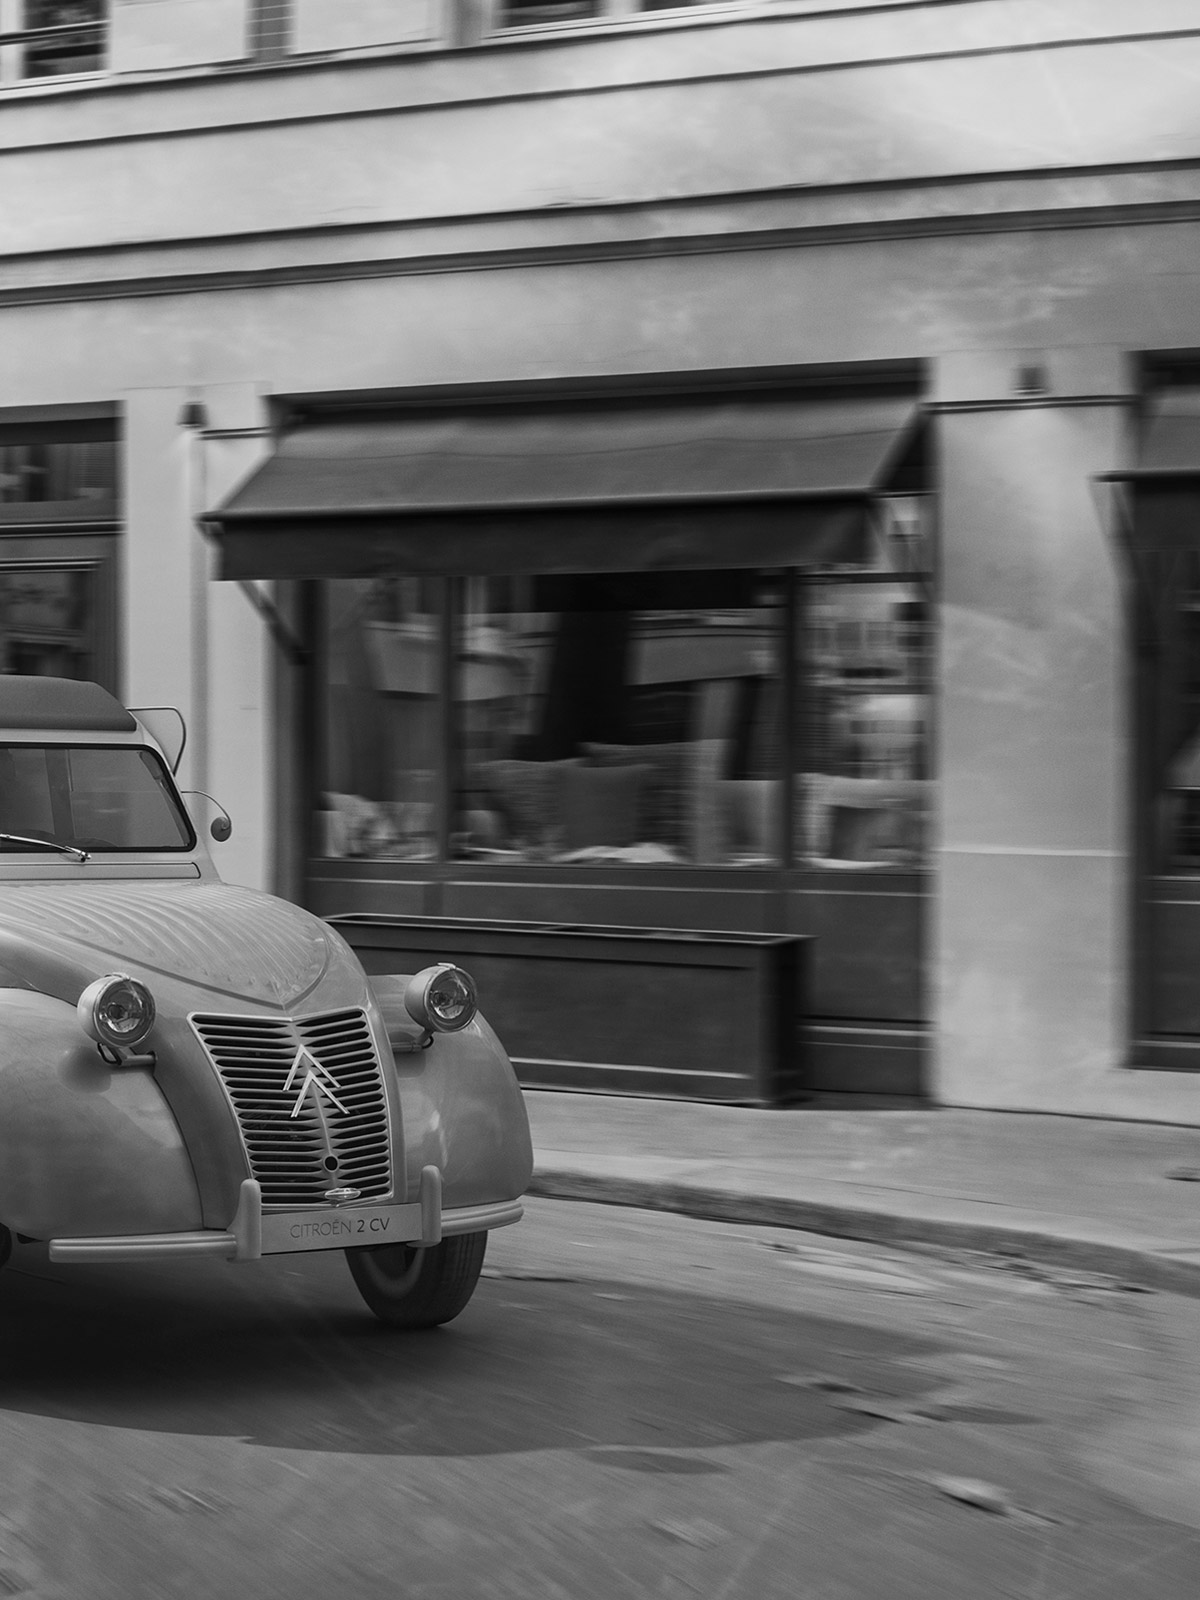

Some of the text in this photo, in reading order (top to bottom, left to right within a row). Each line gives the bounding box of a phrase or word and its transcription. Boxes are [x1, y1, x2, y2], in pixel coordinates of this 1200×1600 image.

[290, 1217, 390, 1238] CITROËN 2 CV
